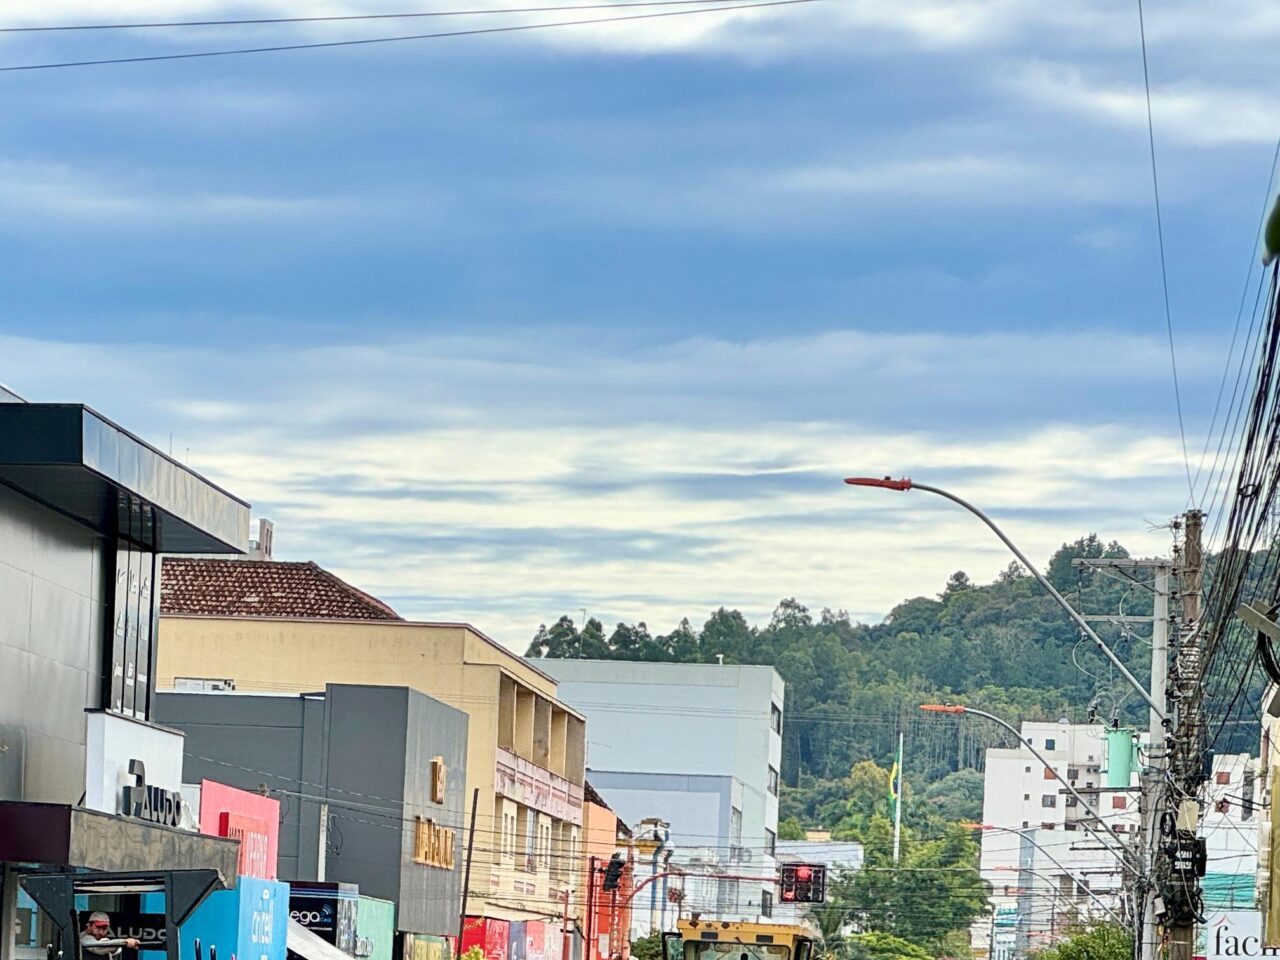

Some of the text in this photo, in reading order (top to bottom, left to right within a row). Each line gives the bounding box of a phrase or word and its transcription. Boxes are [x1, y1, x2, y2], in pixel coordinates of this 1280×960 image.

[121, 758, 182, 827] PALUDO
[289, 910, 321, 925] ega
[107, 927, 168, 940] ALUDO
[1212, 924, 1280, 956] fac
